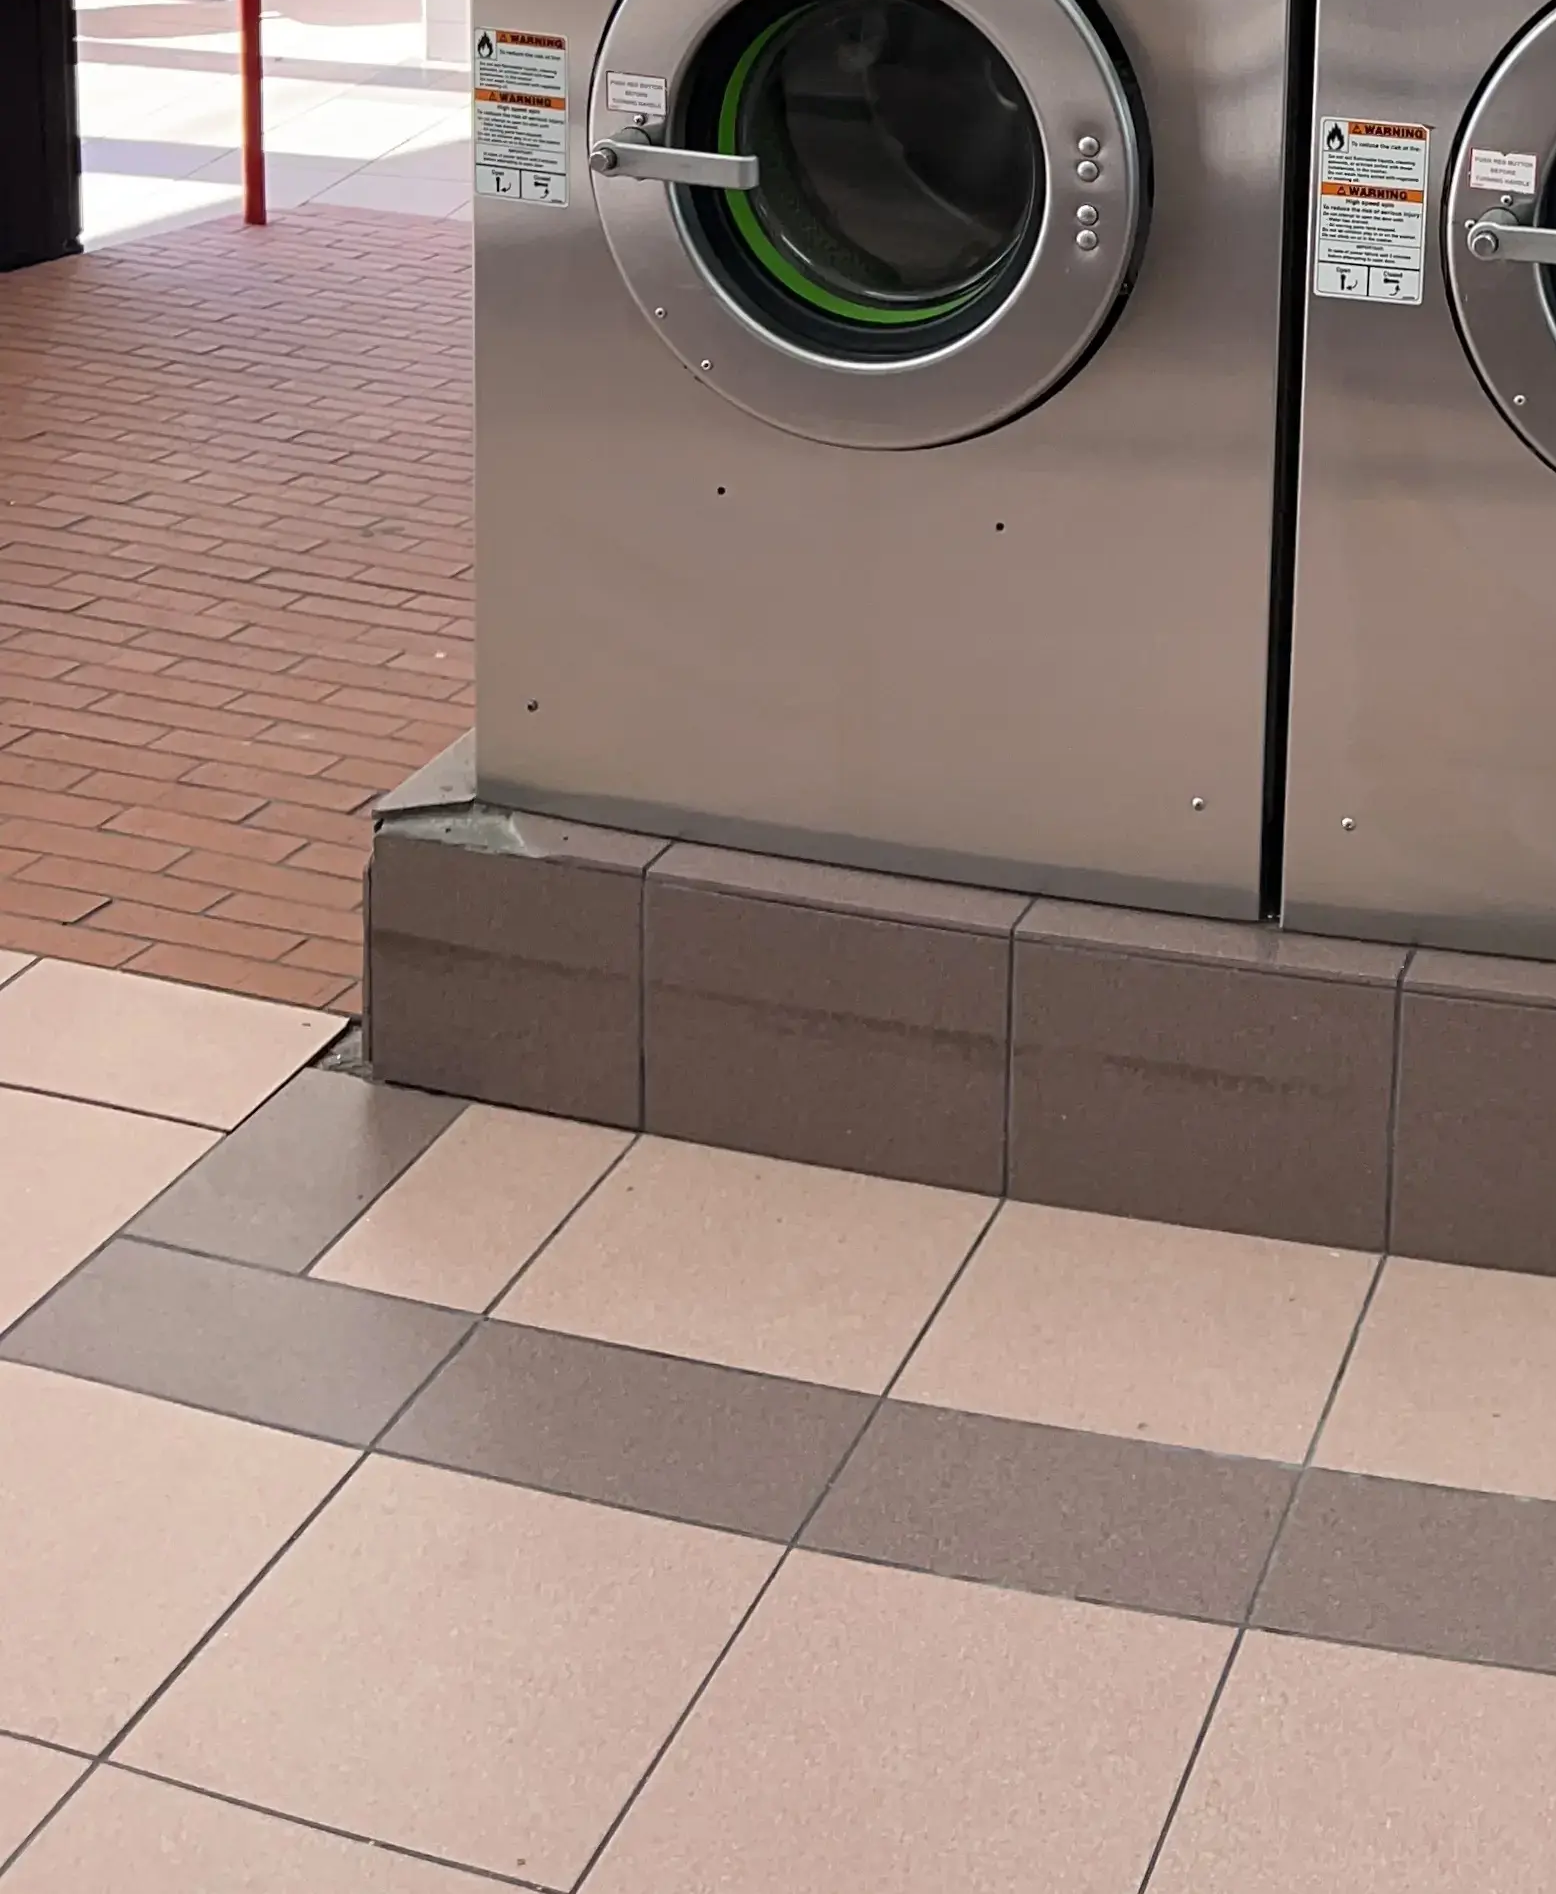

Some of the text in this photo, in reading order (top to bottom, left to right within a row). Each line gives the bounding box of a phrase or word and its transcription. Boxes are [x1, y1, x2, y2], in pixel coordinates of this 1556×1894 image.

[499, 92, 551, 107] WARNING
[1364, 125, 1423, 139] WARNING
[1349, 186, 1408, 200] WARNING
